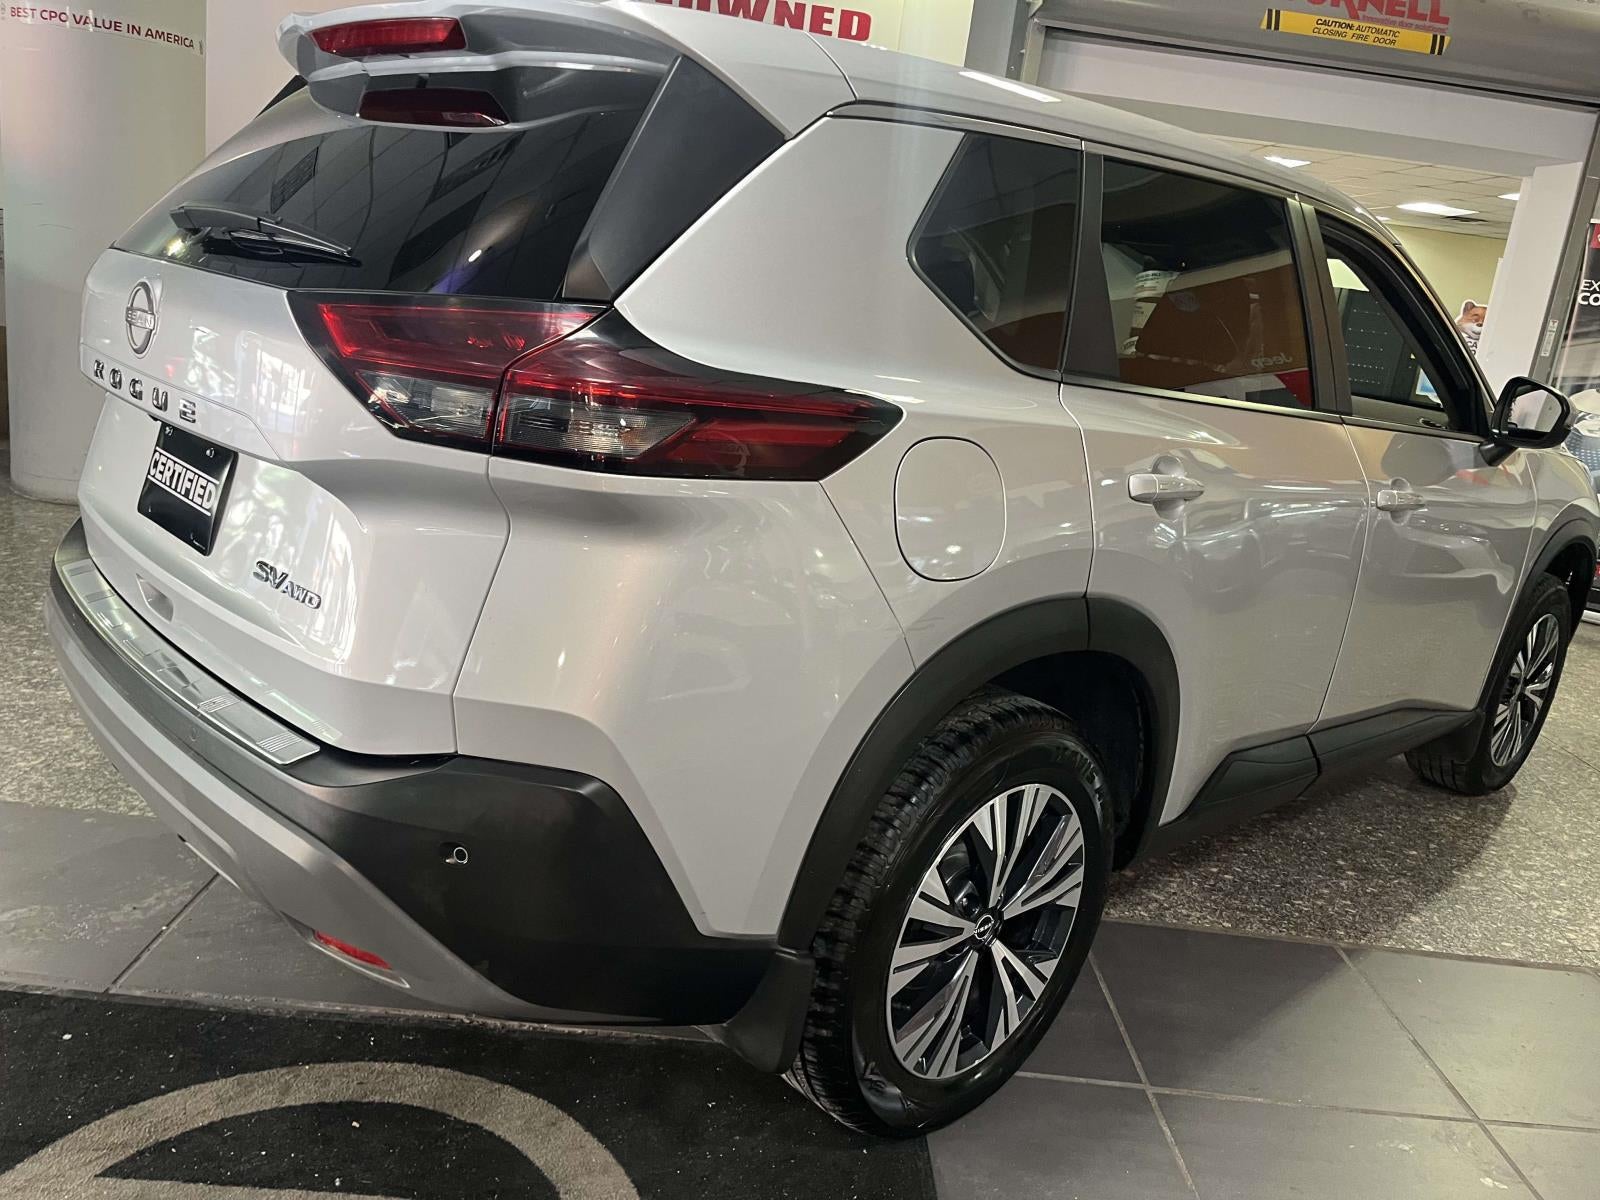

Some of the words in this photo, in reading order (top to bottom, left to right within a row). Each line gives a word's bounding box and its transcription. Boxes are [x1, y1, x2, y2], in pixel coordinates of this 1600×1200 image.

[10, 6, 37, 19] BEST
[40, 9, 69, 23] CPO
[72, 14, 123, 32] VALUE
[127, 23, 142, 36] IN
[144, 28, 194, 49] AMERICA
[1312, 27, 1347, 39] CLOSING
[1351, 33, 1369, 42] FIRE
[1373, 36, 1397, 46] DOOR
[1315, 18, 1355, 31] CAUTION:
[1355, 24, 1400, 38] AUTOMATIC
[94, 360, 196, 423] ROGUE
[149, 451, 216, 510] CERTIFIED
[253, 560, 288, 589] SV
[282, 580, 322, 609] AWD
